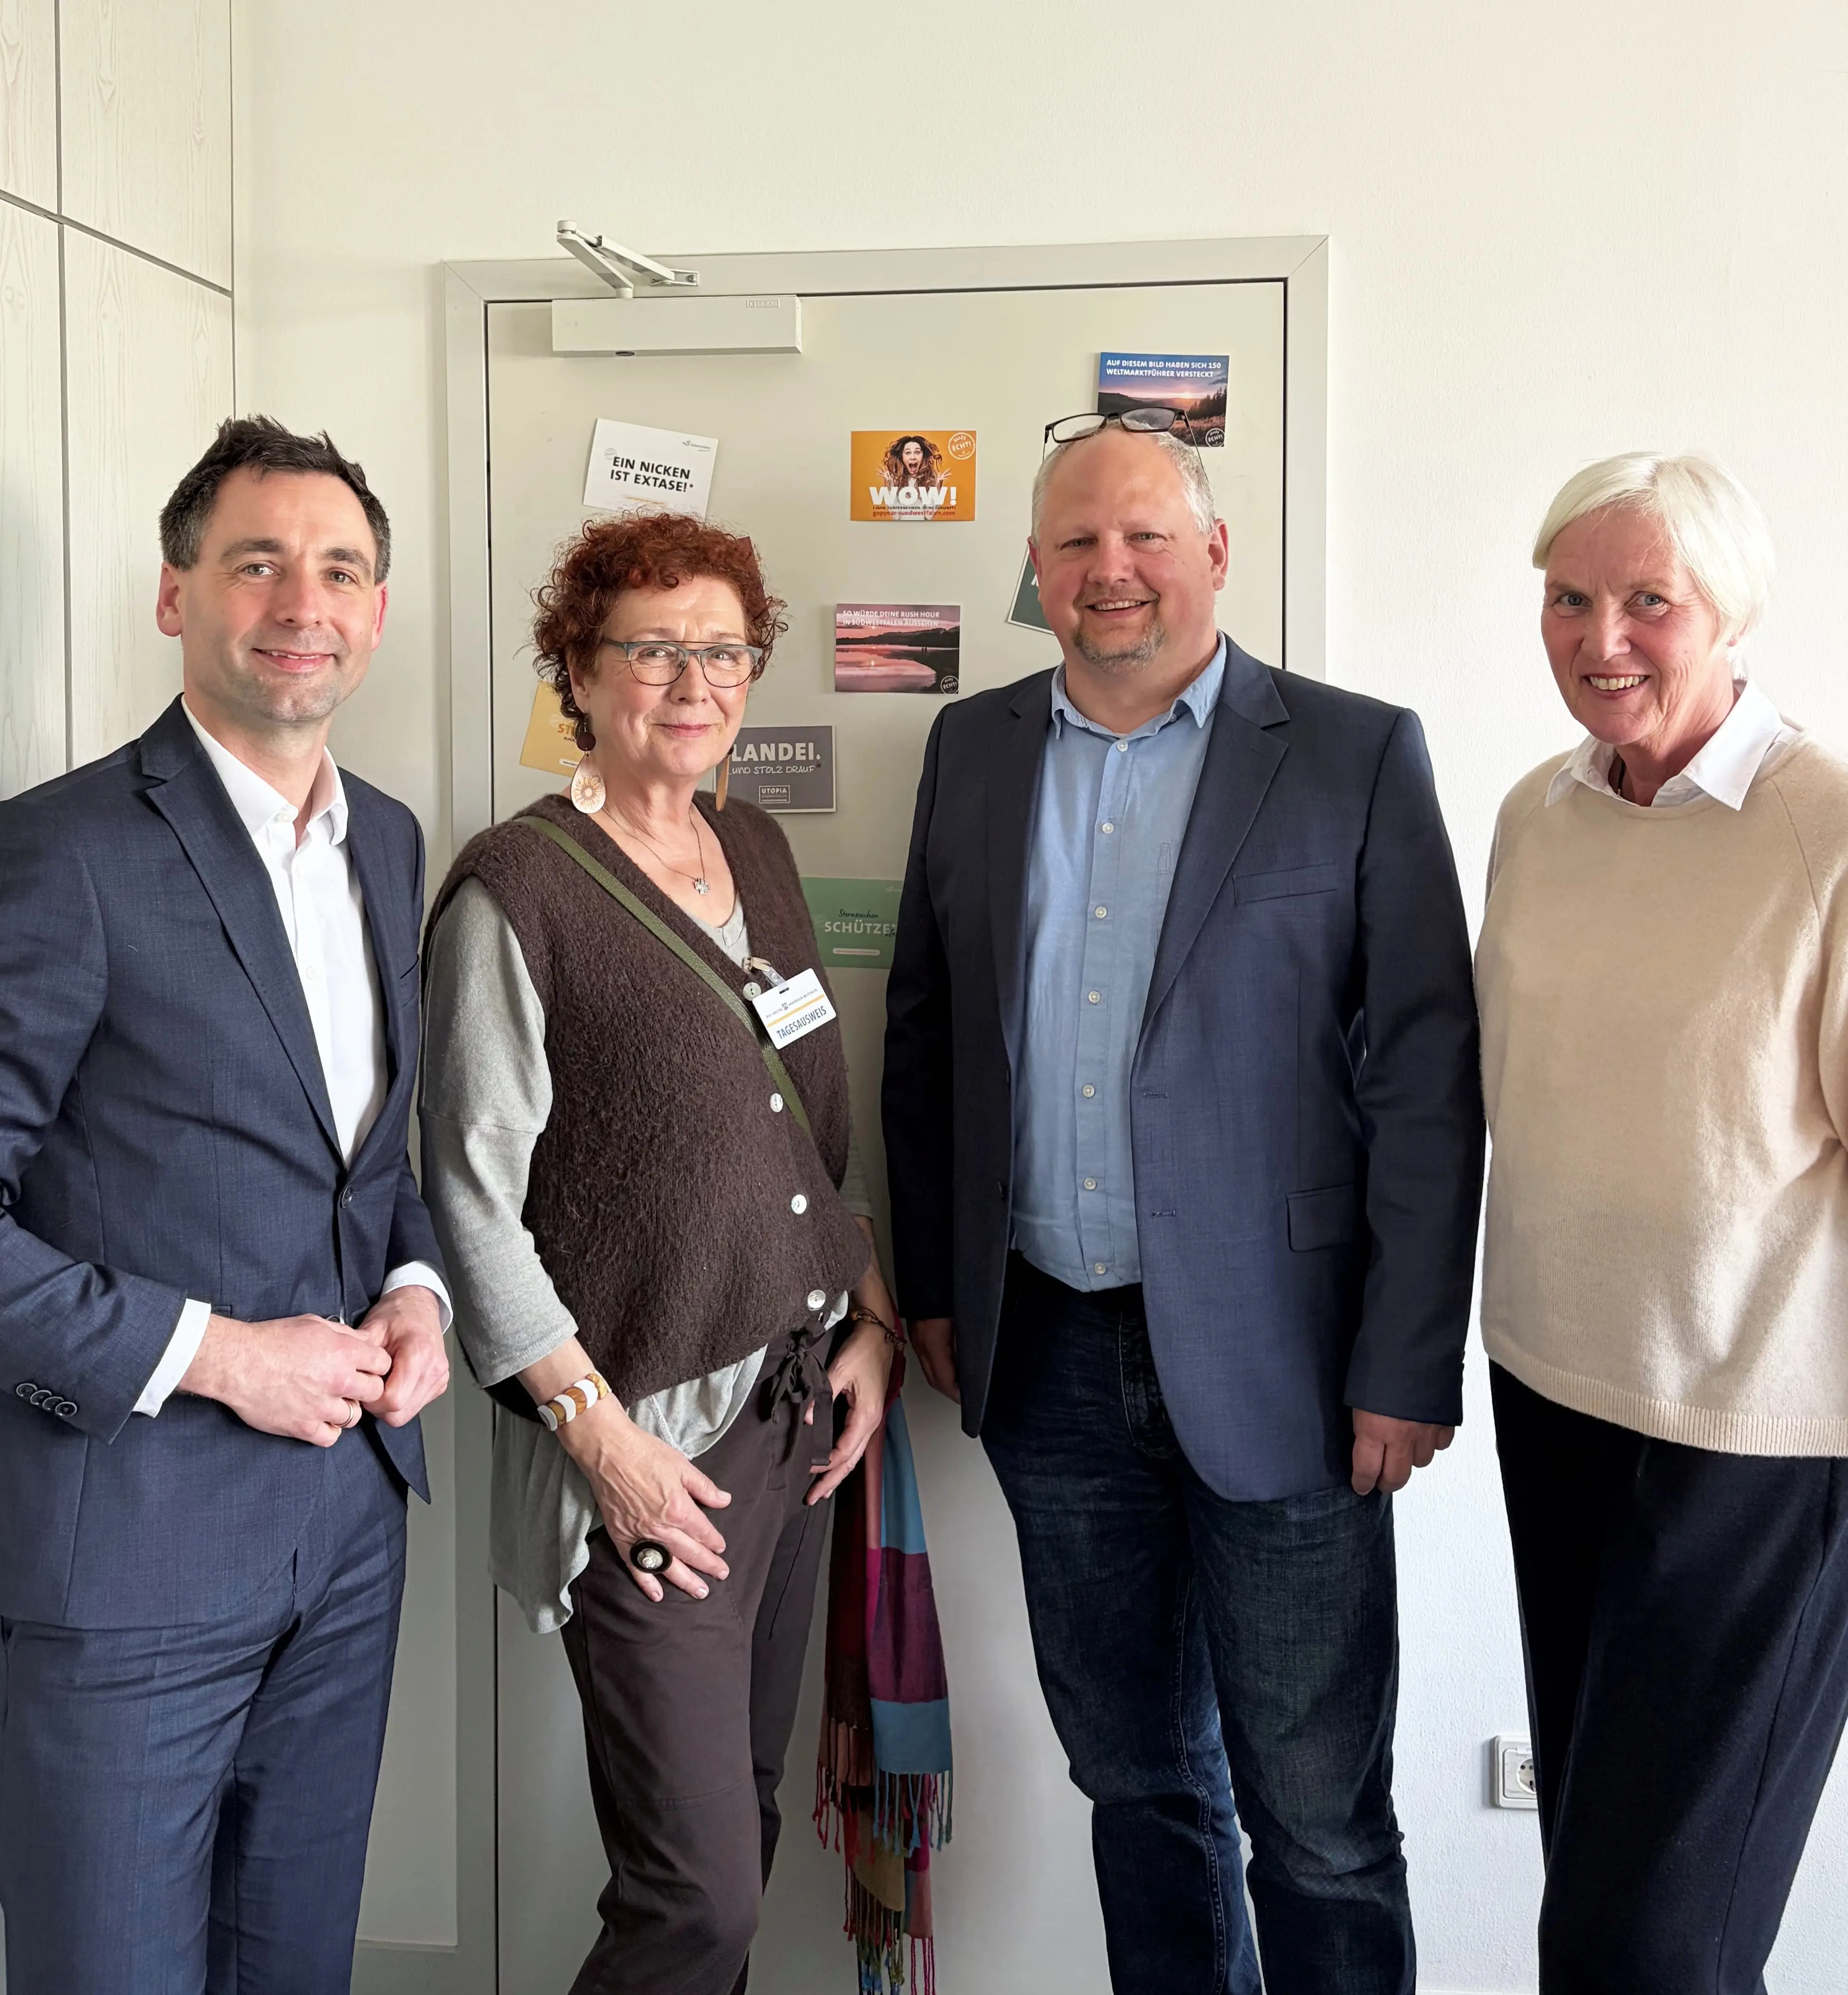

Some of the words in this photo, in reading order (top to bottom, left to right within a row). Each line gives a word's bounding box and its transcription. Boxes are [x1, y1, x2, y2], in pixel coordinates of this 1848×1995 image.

[1106, 368, 1175, 377] WELTMARKTFÜHRER
[952, 441, 972, 452] ECHT!
[612, 456, 635, 469] EIN
[640, 461, 690, 479] NICKEN
[610, 469, 630, 482] IST
[869, 486, 957, 505] WOW!
[853, 609, 880, 617] WÜRDE
[732, 743, 821, 761] LANDEI.
[754, 766, 783, 774] STOLZ
[839, 909, 879, 918] Sternzeichen
[776, 1005, 827, 1039] TAGESAUSWEIS
